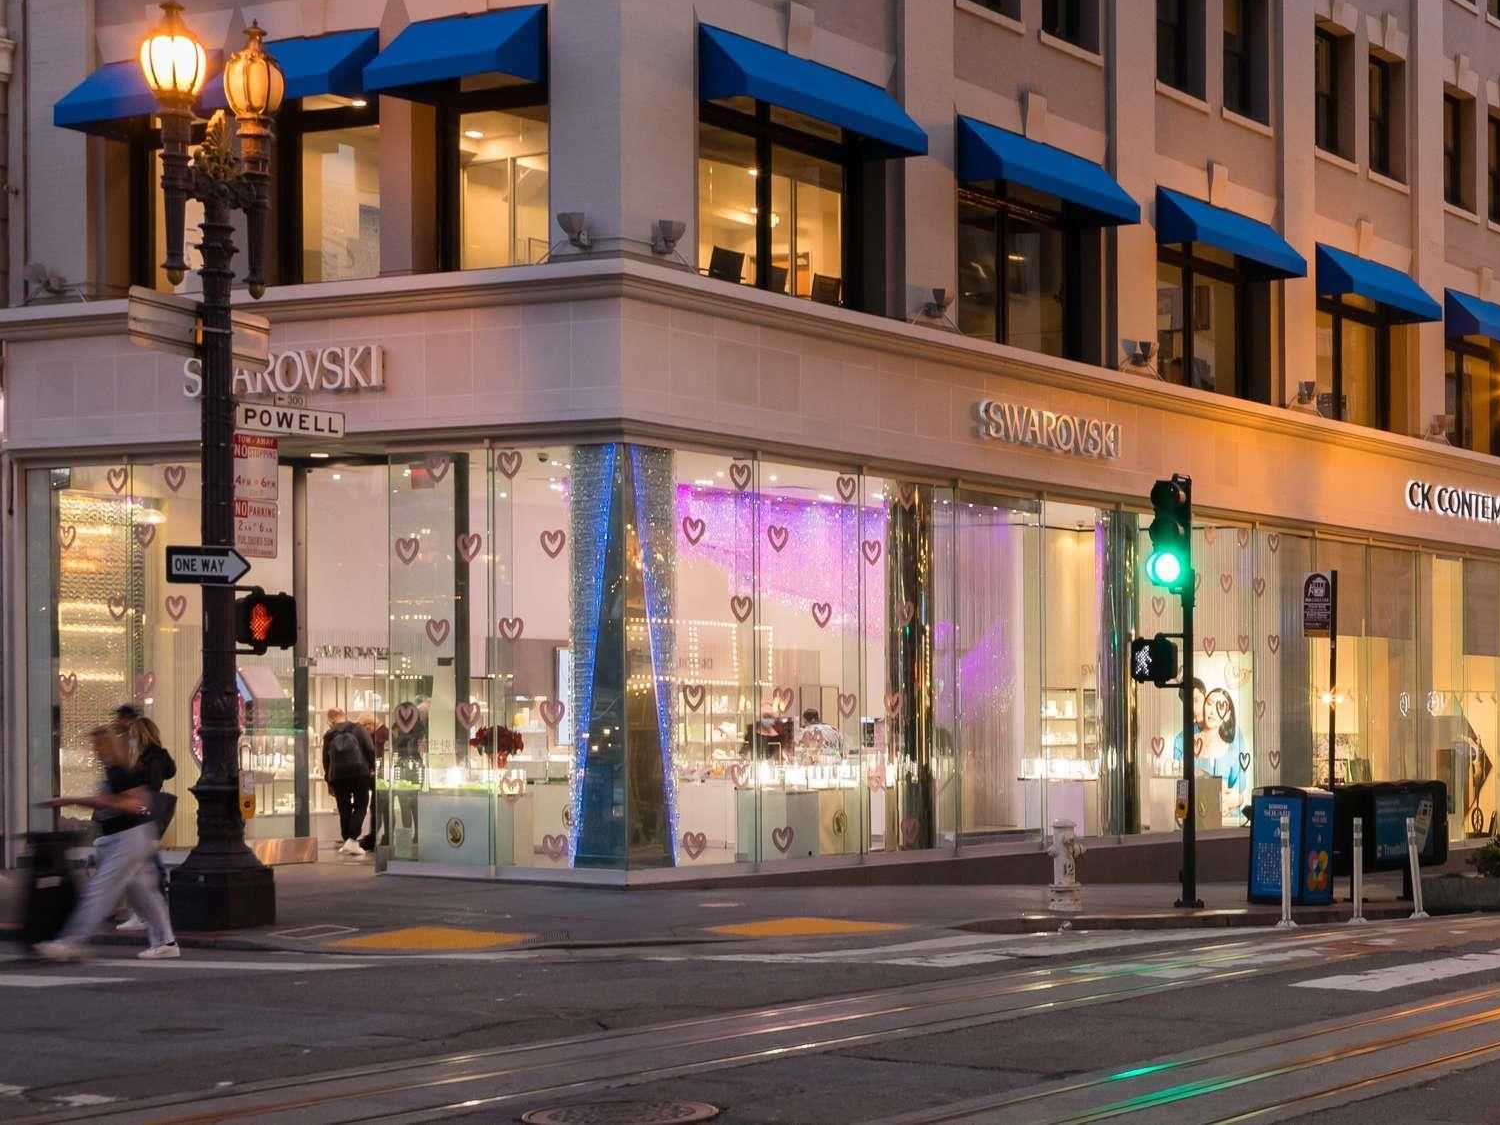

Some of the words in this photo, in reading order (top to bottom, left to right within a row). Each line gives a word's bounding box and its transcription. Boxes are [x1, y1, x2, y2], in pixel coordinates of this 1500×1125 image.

[183, 344, 385, 397] SAROVSKI
[244, 408, 339, 434] POWELL
[986, 401, 1122, 459] SWAROVSKI
[234, 444, 248, 458] NO
[1407, 480, 1433, 511] CK
[235, 499, 248, 518] NO
[249, 505, 276, 519] PARKING
[174, 558, 197, 573] ONE
[201, 559, 225, 573] WAY
